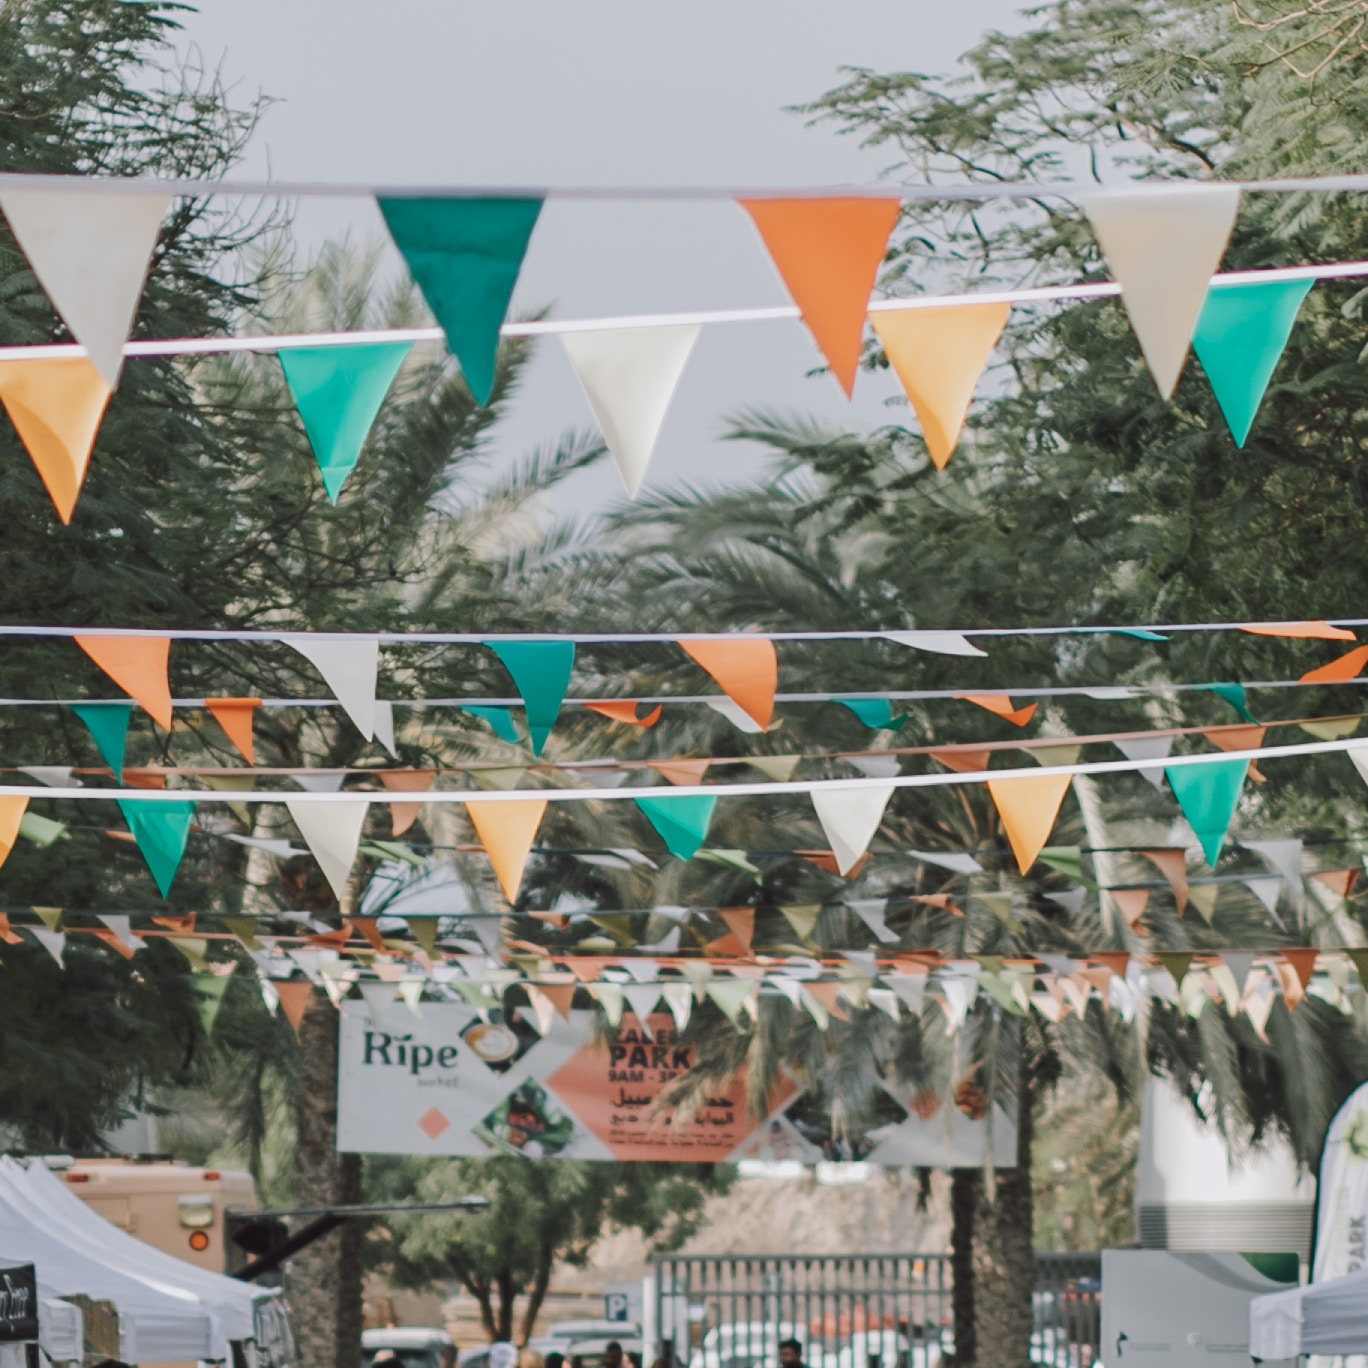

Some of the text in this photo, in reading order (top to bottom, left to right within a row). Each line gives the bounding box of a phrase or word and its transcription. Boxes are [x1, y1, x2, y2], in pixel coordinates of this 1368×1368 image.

[362, 1031, 459, 1075] Ripe
[610, 1046, 692, 1069] PARK
[608, 1071, 644, 1083] 9AM
[659, 1071, 678, 1083] 3P
[609, 1296, 625, 1320] P
